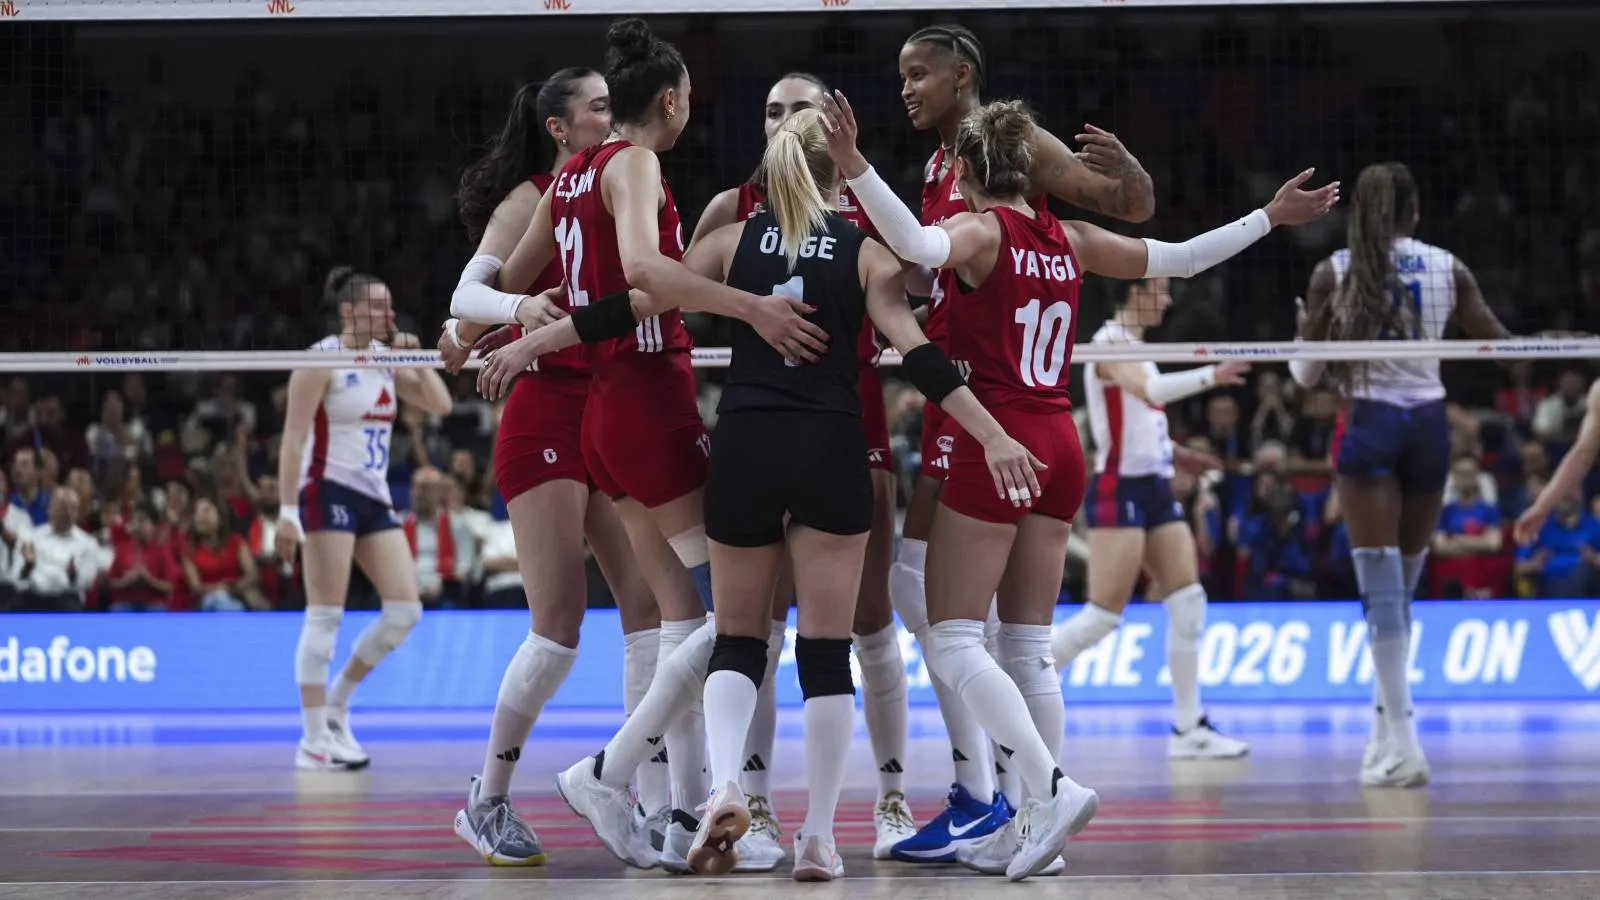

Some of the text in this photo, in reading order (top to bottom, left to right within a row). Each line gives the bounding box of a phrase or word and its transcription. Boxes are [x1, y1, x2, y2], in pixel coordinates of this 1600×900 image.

[95, 356, 159, 365] VOLLEYBALL
[1015, 298, 1072, 387] 10
[364, 428, 388, 469] 35
[330, 504, 350, 526] 35
[1056, 618, 1529, 686] HE 026 VL ON
